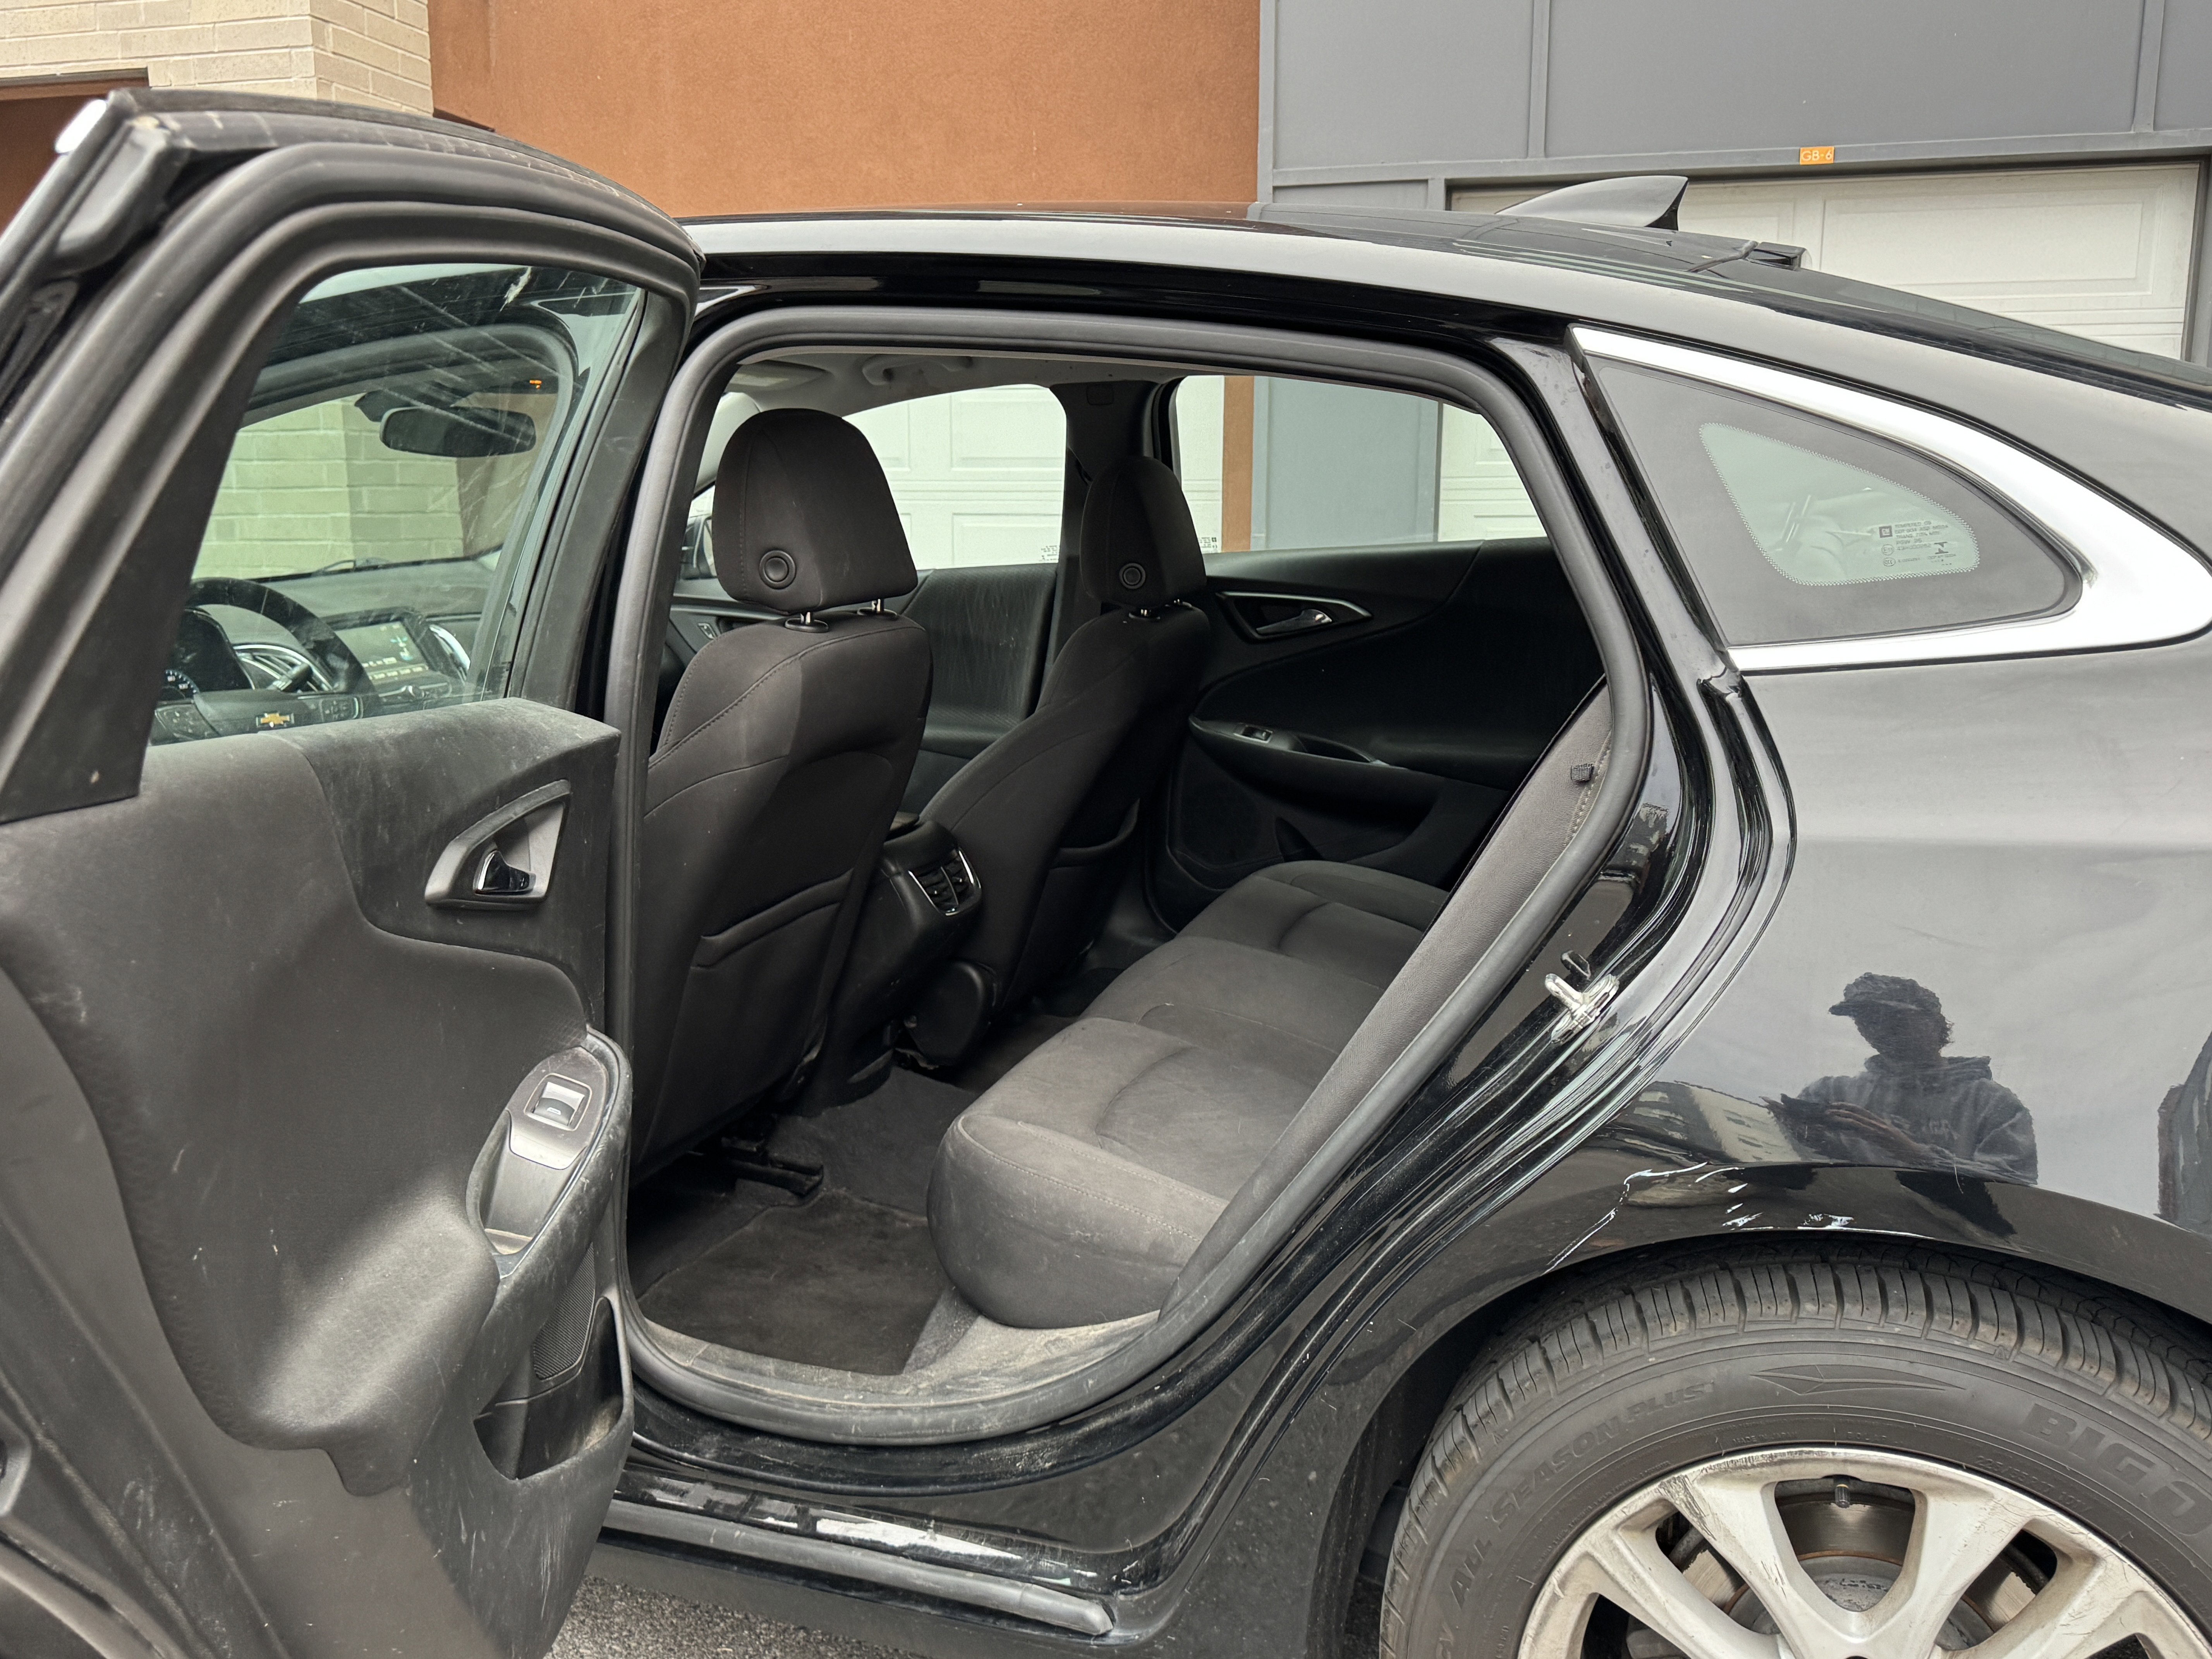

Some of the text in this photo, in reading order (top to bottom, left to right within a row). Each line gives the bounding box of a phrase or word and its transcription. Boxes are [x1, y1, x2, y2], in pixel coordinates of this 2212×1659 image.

[1801, 149, 1833, 161] GB-6
[1732, 1435, 1757, 1445] MADE
[1448, 1383, 1707, 1610] ALL SEASON PLUS
